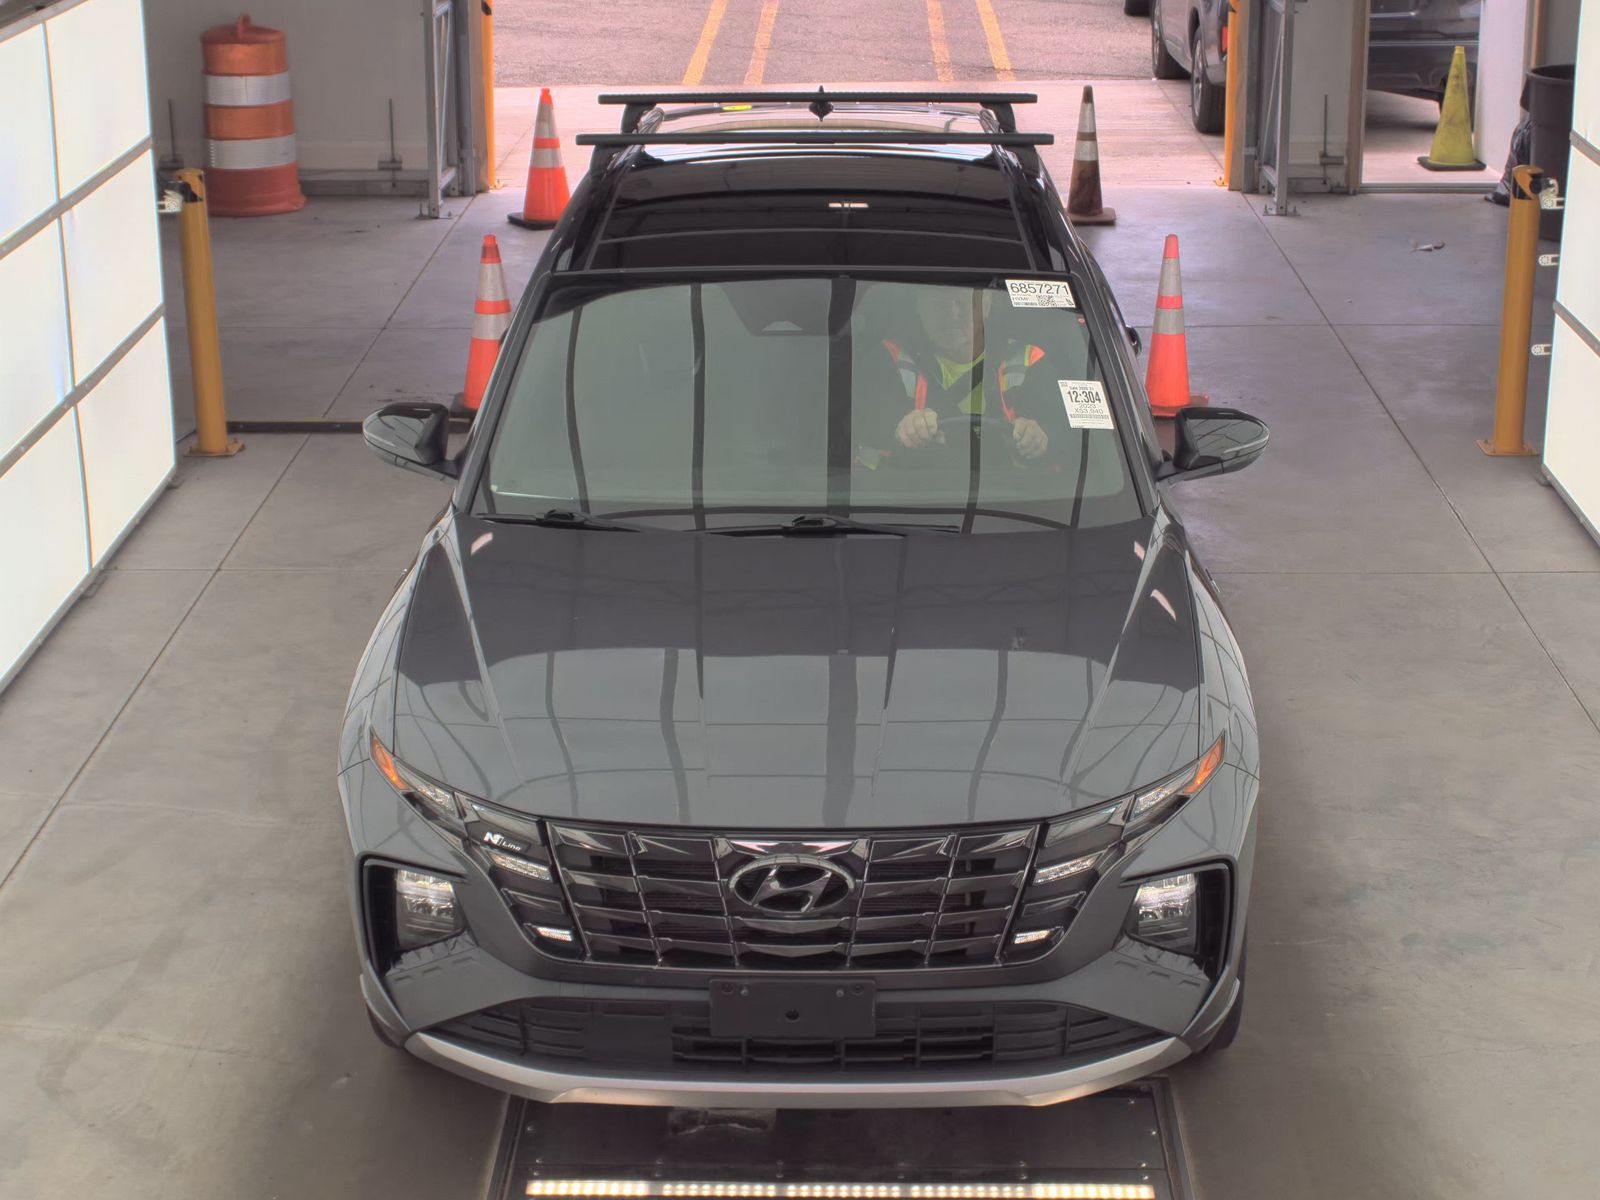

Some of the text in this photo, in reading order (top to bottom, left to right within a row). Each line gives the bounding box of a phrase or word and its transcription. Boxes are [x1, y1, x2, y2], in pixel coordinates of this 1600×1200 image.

[1010, 282, 1069, 295] 6857271
[1067, 390, 1101, 403] 12:304
[502, 841, 521, 851] Line
